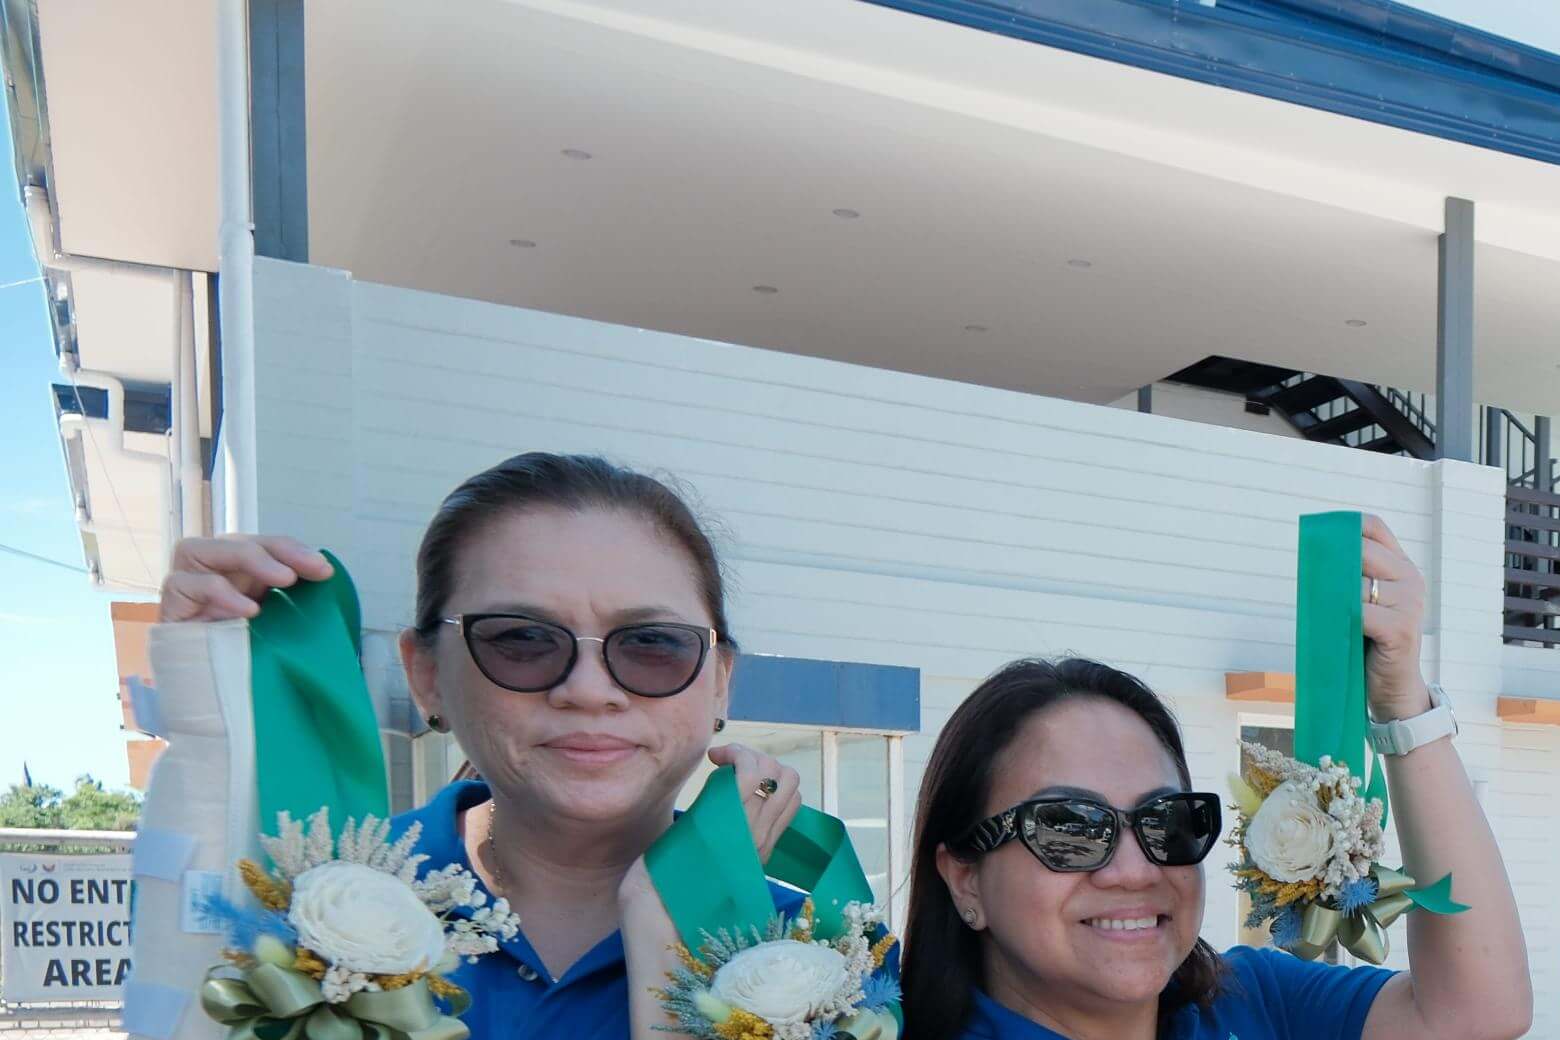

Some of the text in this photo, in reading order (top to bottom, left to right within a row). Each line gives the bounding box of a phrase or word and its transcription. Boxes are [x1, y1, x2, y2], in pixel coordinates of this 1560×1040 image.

[11, 878, 136, 905] NO ENT
[43, 957, 132, 988] AREA
